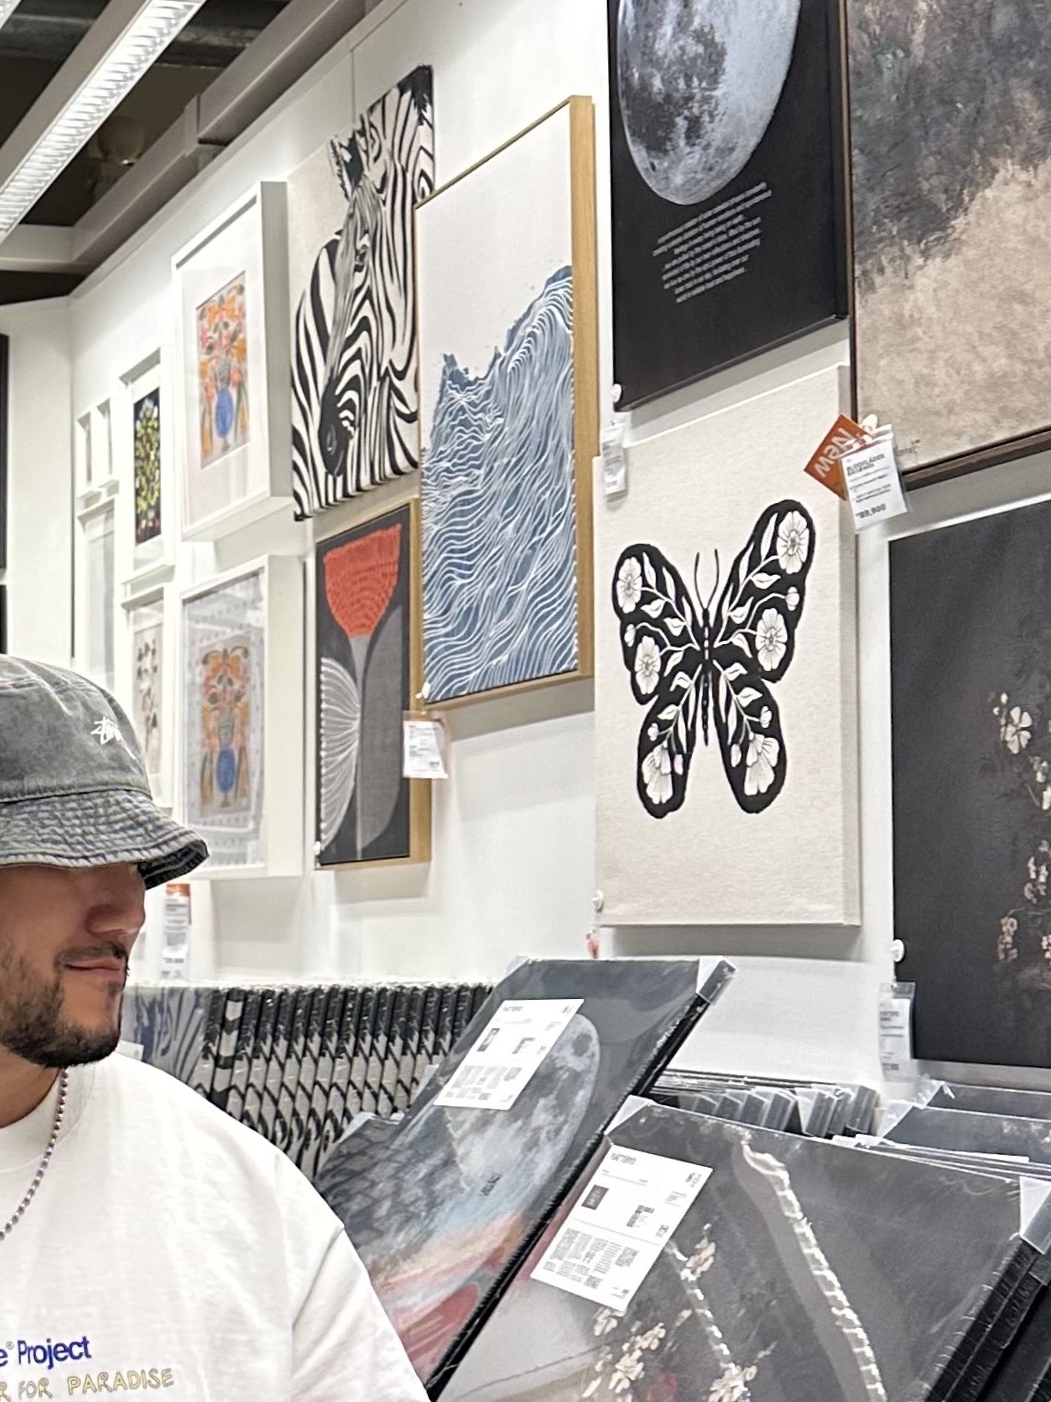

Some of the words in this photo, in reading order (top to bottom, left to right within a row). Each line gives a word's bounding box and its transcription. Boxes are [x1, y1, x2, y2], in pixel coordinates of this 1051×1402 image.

[17, 1336, 92, 1370] Project
[18, 1376, 53, 1400] FOR
[66, 1367, 175, 1396] PARADISE
